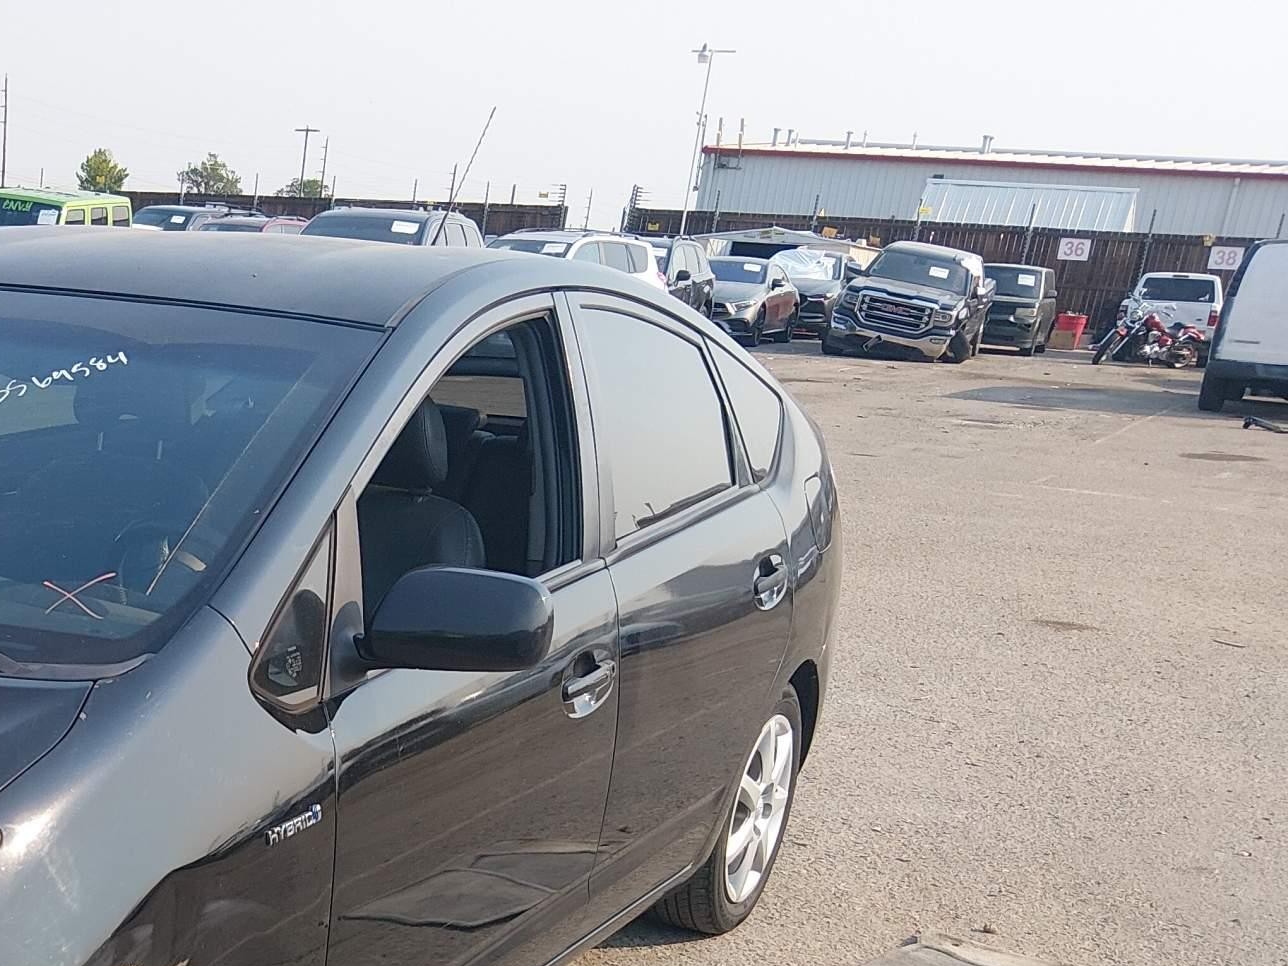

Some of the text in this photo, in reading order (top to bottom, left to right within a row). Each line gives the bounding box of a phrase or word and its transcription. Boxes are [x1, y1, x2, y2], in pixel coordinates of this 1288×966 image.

[1063, 241, 1086, 257] 36
[1214, 250, 1238, 266] 38
[268, 809, 315, 846] HYBRID
